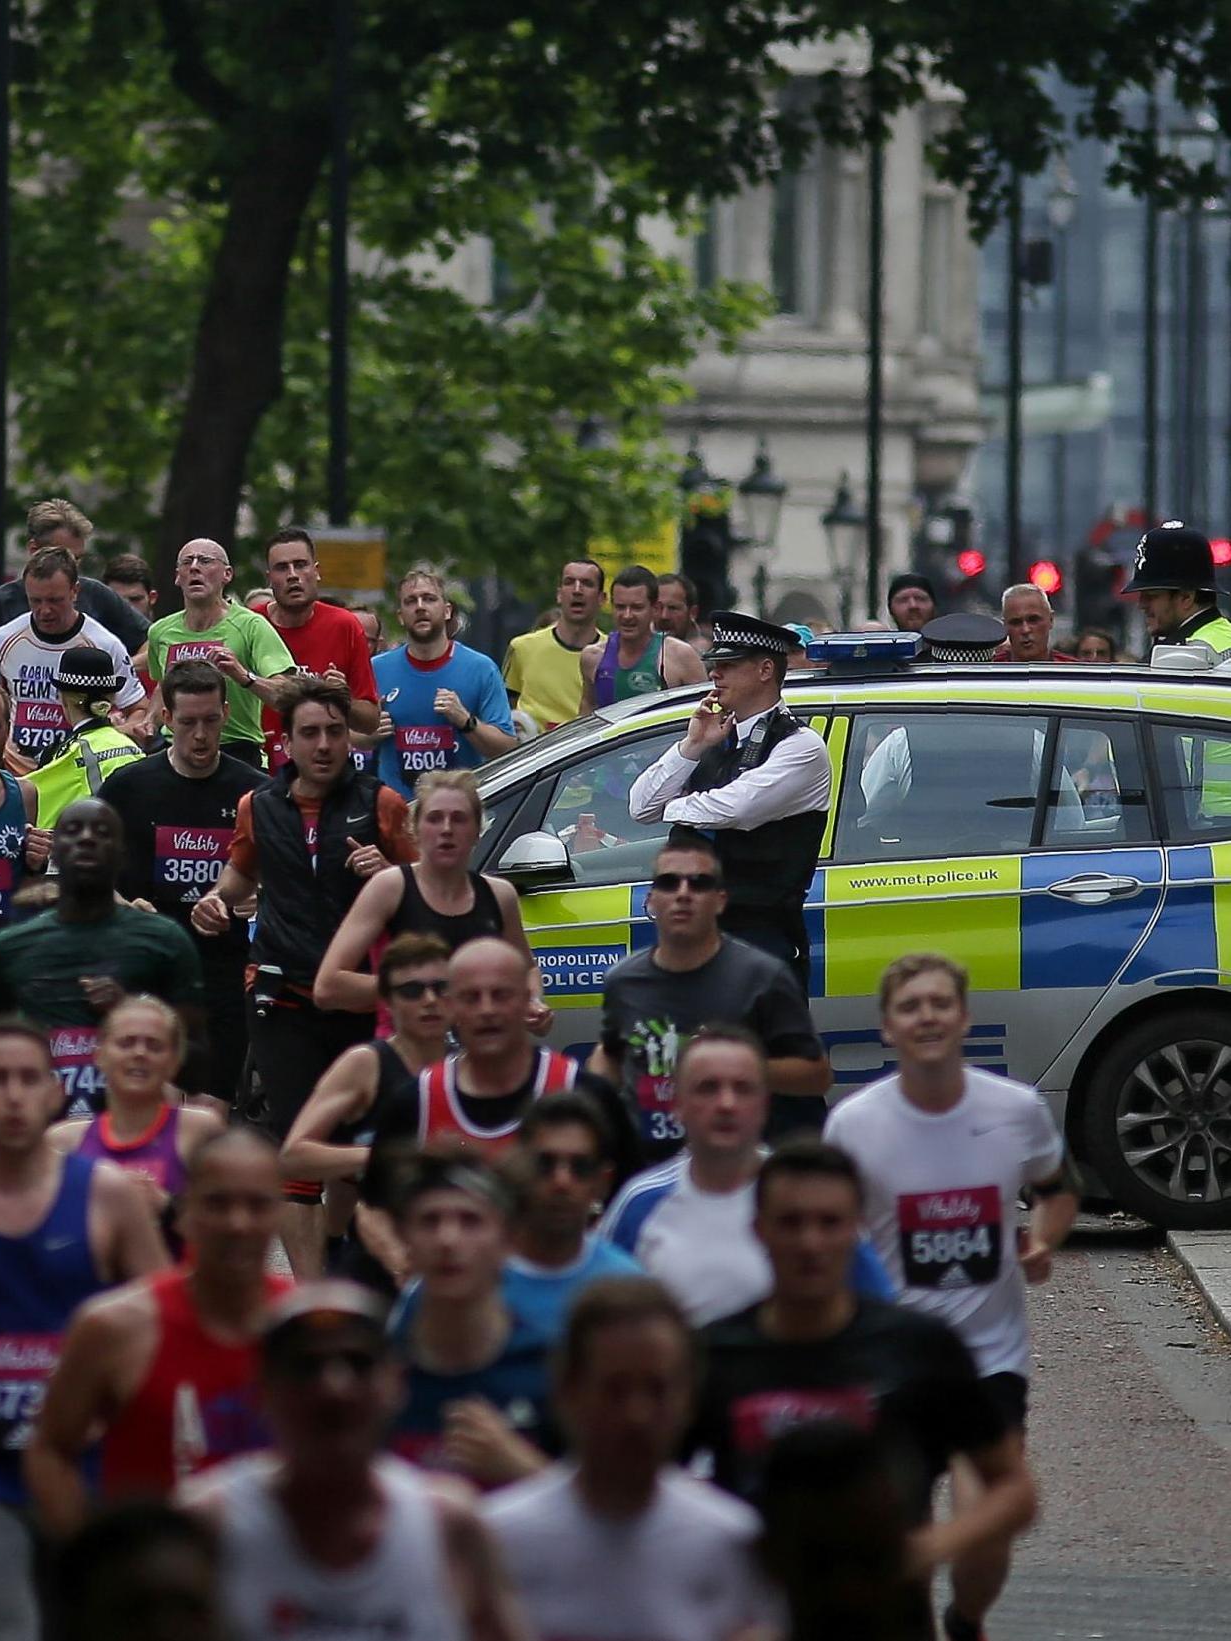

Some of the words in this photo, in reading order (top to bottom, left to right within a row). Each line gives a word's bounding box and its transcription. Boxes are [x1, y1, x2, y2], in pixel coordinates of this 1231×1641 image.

[12, 679, 50, 699] TEAM
[26, 704, 64, 727] Vitality
[404, 728, 442, 749] Vitality
[402, 750, 448, 771] 2604
[173, 829, 220, 856] Vitality
[163, 858, 224, 884] 3580
[849, 868, 999, 889] www.met.police.uk
[533, 953, 619, 968] ROPOLITAN
[541, 971, 605, 988] OLICE
[915, 1195, 981, 1225] Vitality
[911, 1225, 991, 1263] 5864
